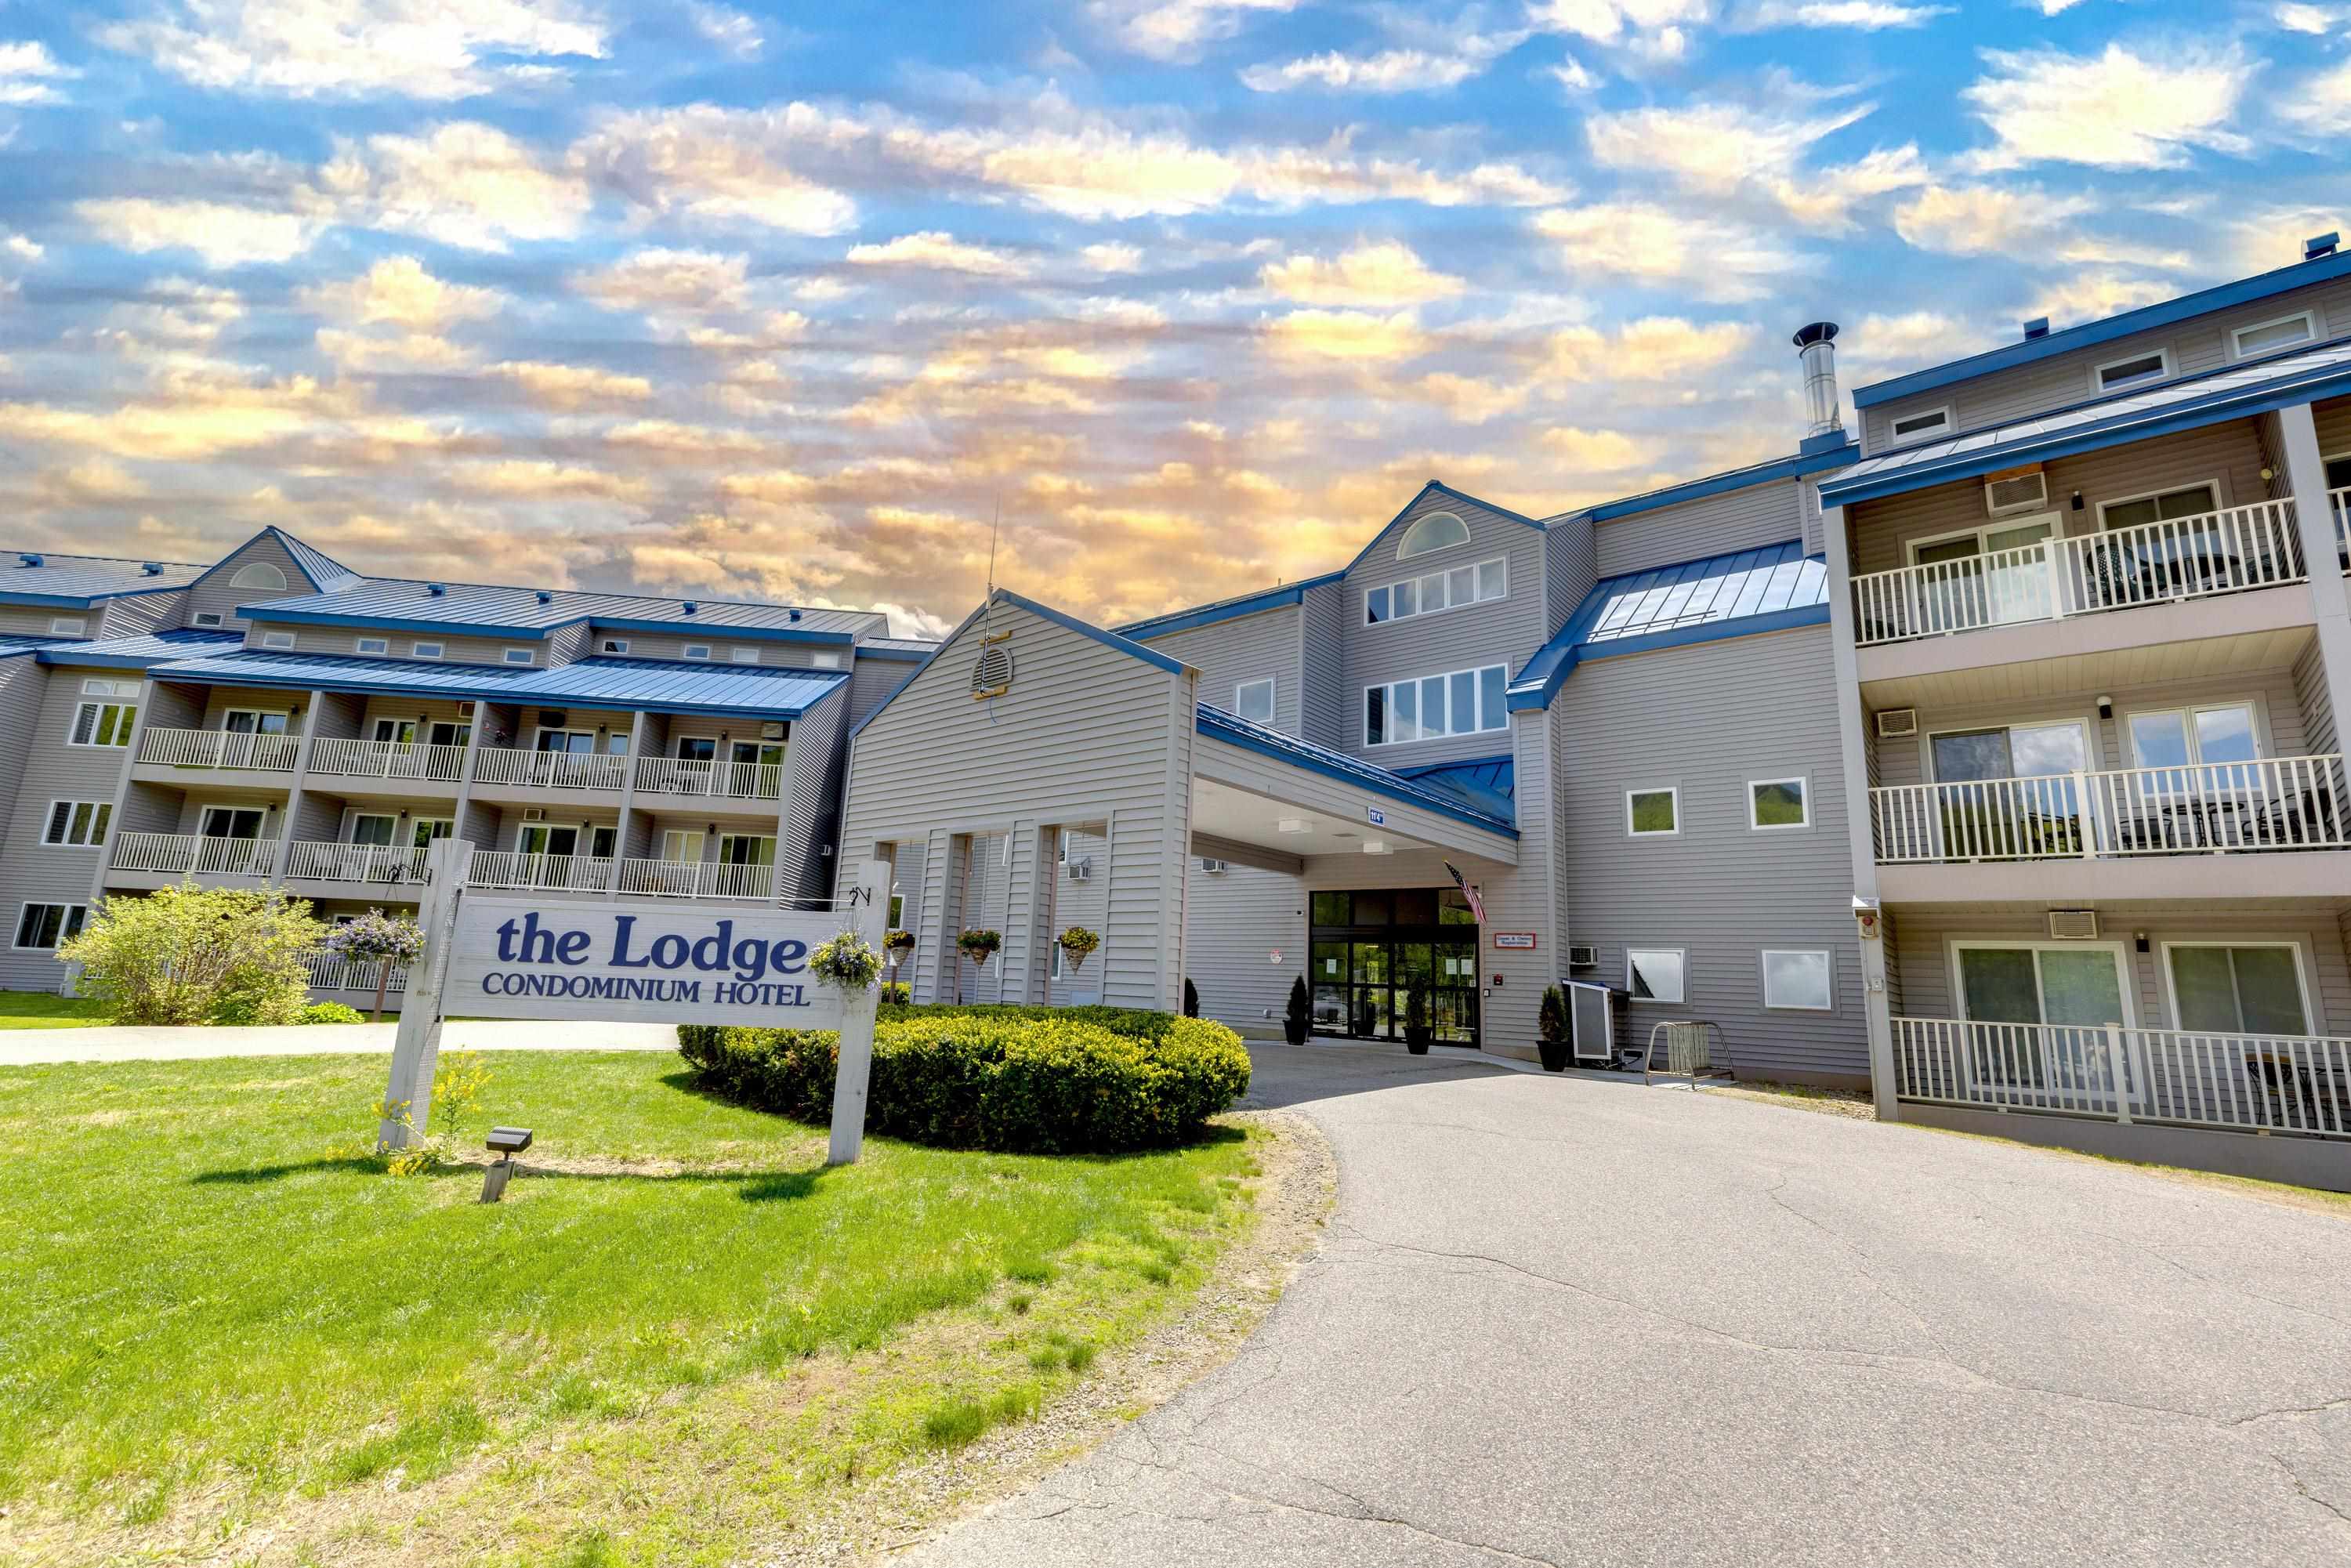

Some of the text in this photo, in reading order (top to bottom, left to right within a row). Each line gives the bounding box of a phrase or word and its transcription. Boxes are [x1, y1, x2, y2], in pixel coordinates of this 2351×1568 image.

[496, 912, 807, 983] the Lodge
[482, 972, 810, 1007] CONDOMINIUM HOTEL
